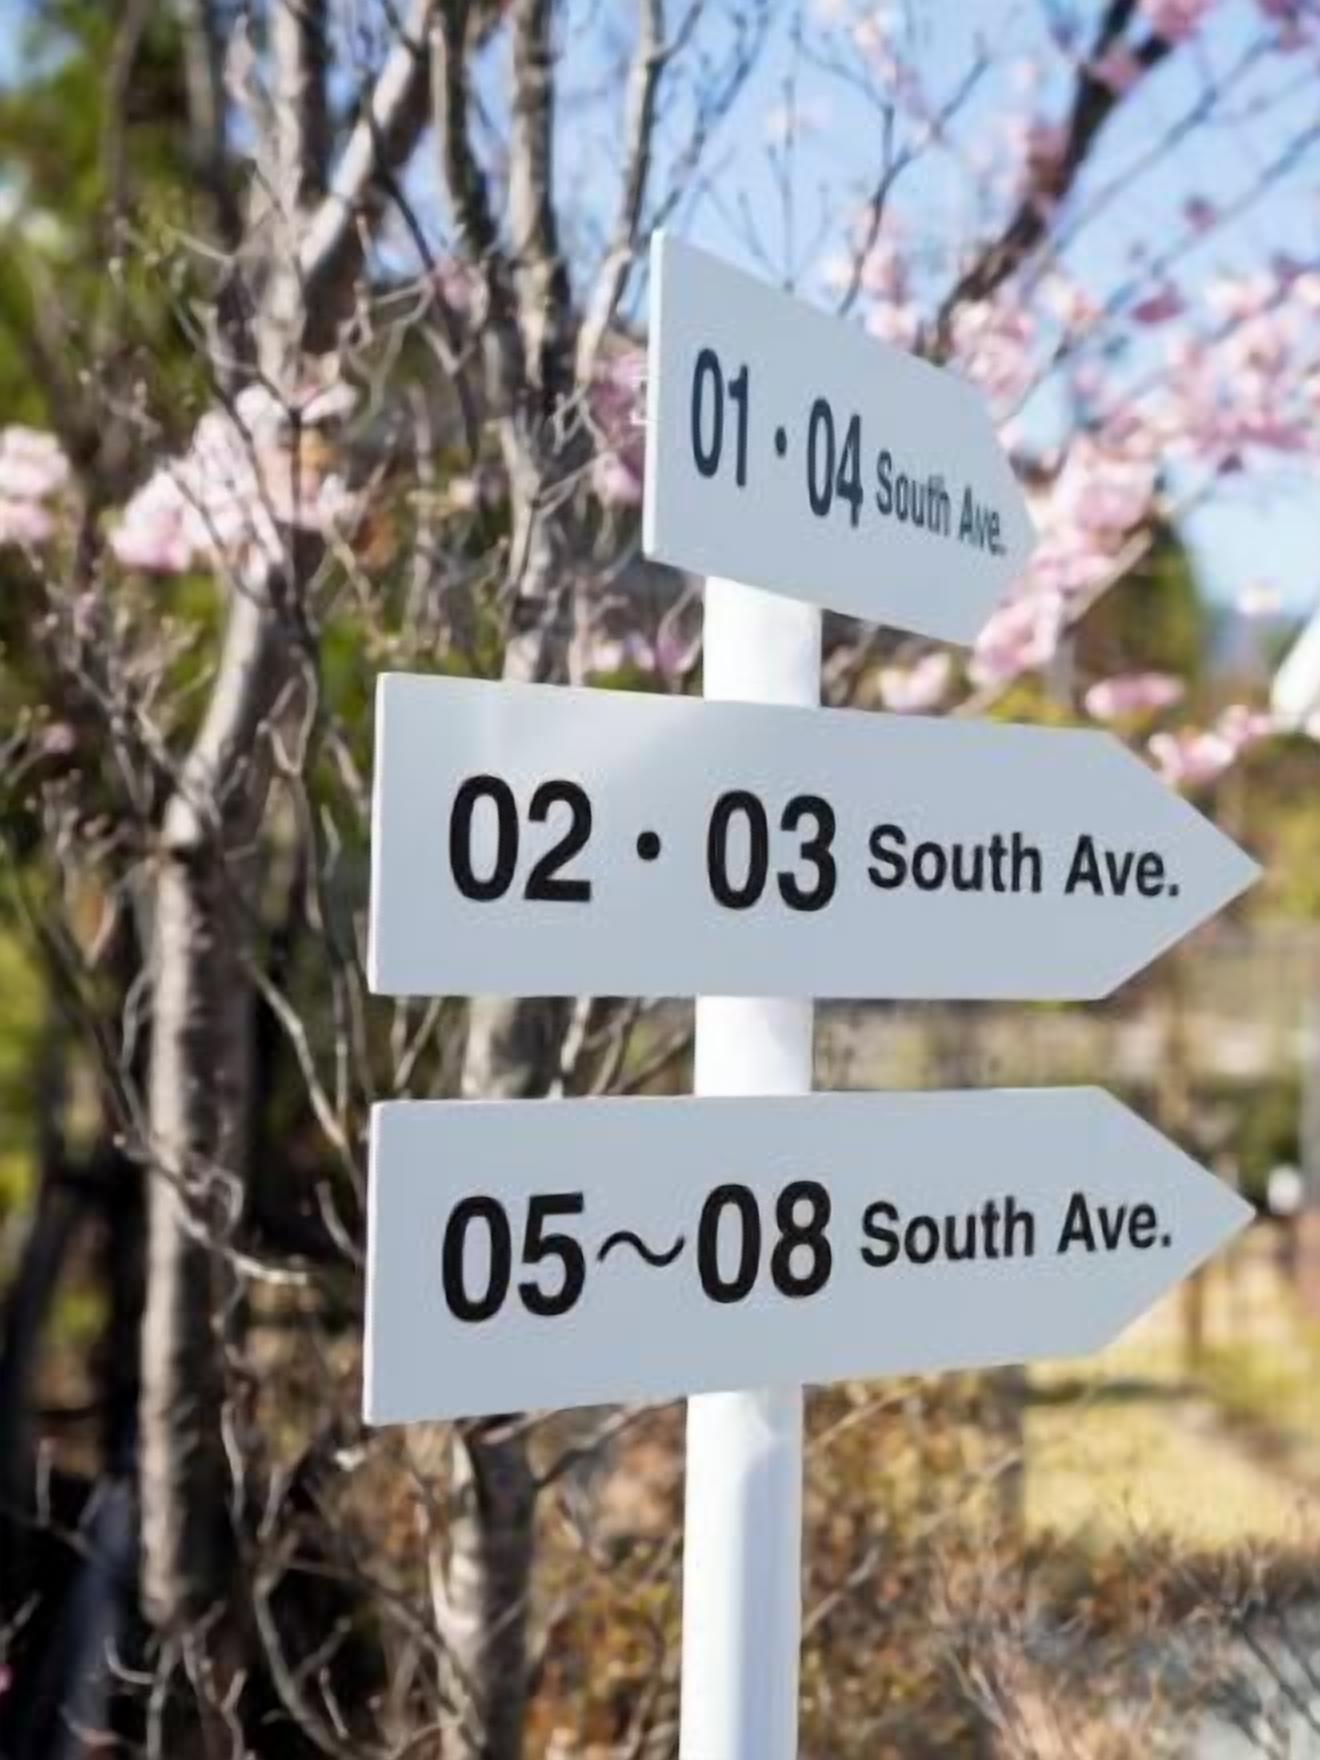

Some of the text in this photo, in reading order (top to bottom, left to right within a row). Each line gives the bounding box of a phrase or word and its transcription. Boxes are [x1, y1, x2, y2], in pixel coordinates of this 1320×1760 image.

[875, 450, 950, 536] South
[958, 486, 1006, 556] Ave.
[867, 823, 1043, 894] South
[1063, 833, 1180, 899] Ave.
[859, 1195, 1036, 1268] South
[1056, 1191, 1172, 1255] Ave.
